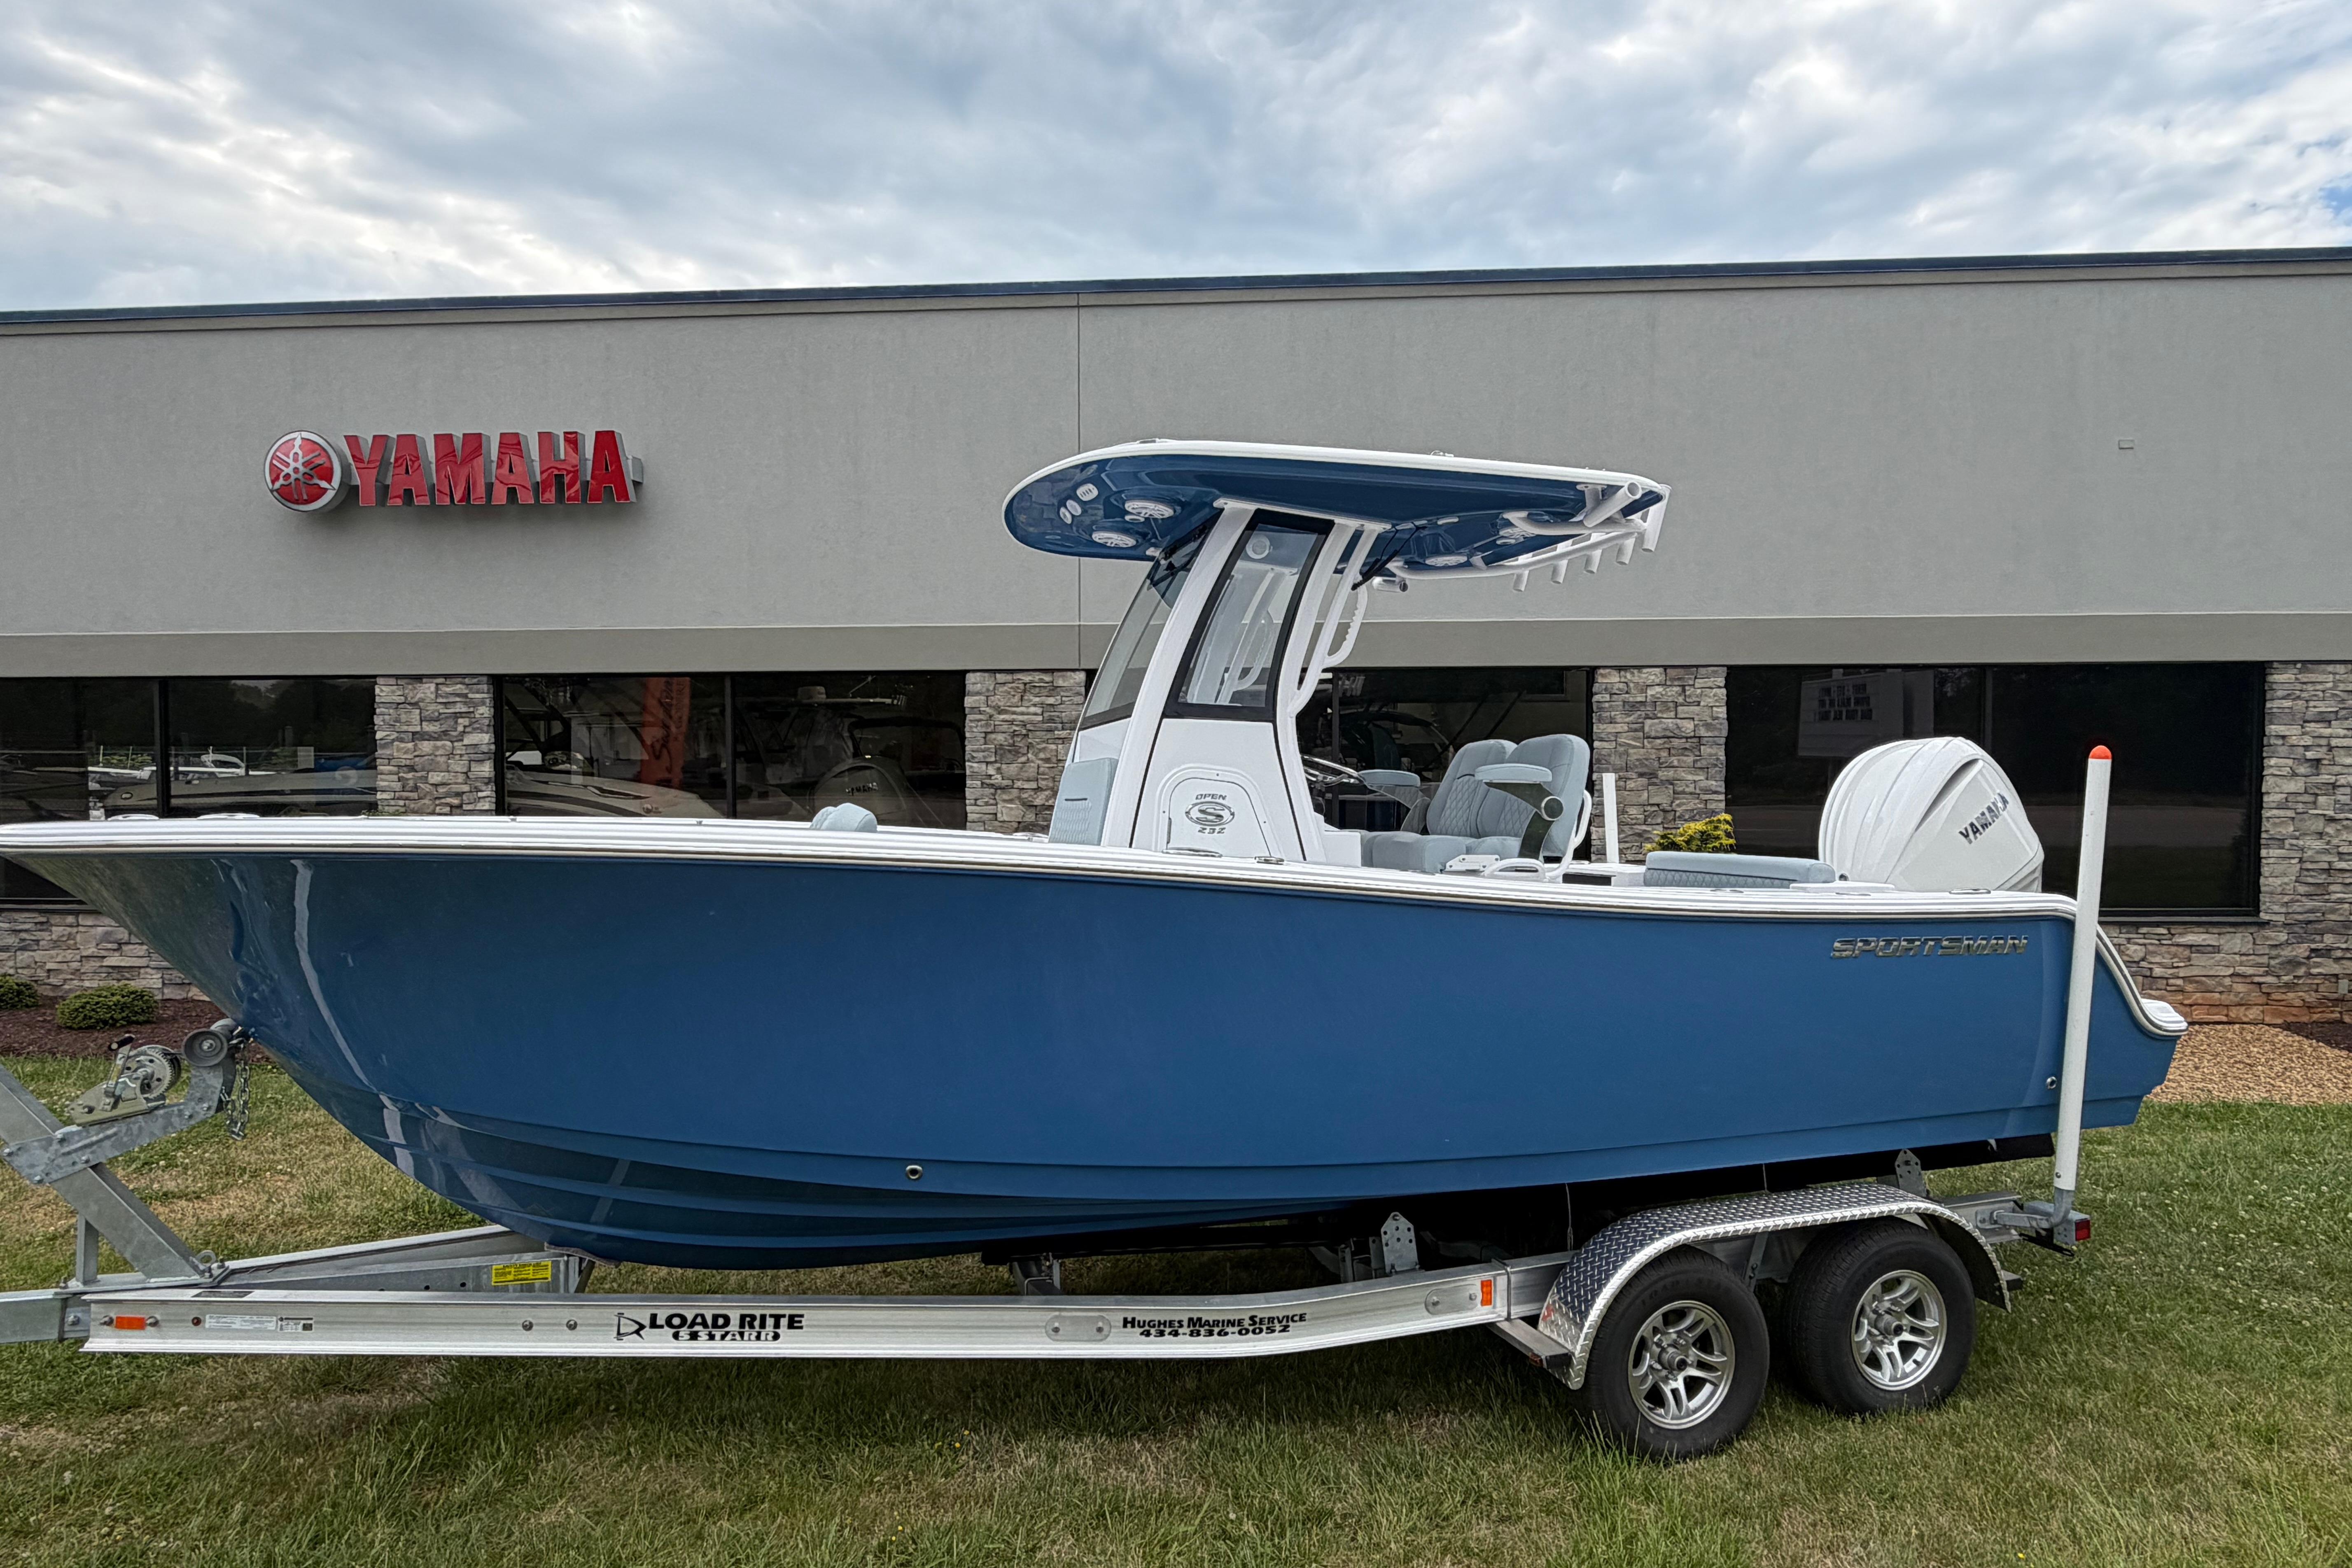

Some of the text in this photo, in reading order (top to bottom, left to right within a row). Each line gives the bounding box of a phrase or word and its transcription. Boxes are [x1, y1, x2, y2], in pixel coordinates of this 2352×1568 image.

[343, 430, 633, 506] YAMAHA
[1958, 792, 2009, 845] YAMAHA
[1831, 935, 2028, 959] SPORTSMAN
[649, 1313, 805, 1330] LOAD RITE
[1122, 1313, 1307, 1328] HUGHES MARINE SERVICE
[678, 1331, 775, 1341] 5 STARR
[1139, 1324, 1290, 1337] 434-836-0052
